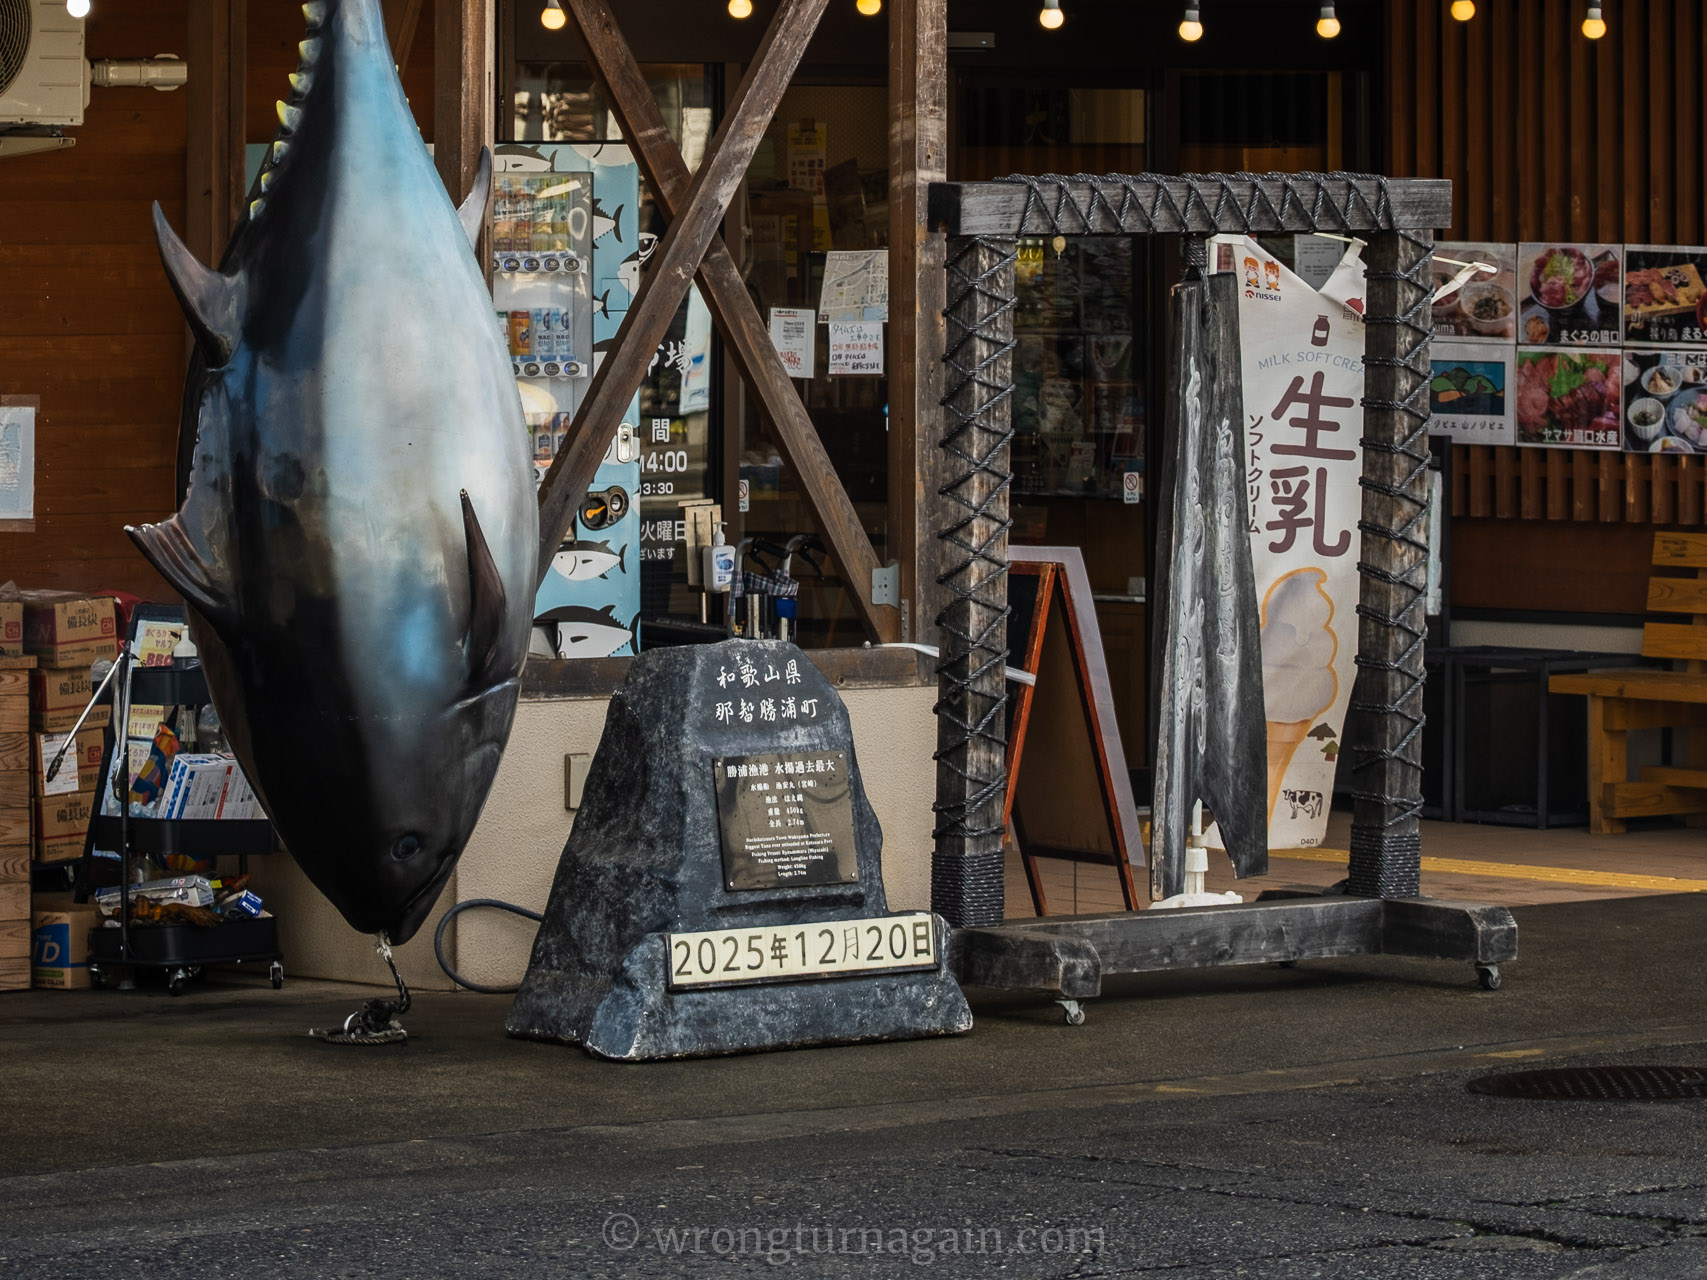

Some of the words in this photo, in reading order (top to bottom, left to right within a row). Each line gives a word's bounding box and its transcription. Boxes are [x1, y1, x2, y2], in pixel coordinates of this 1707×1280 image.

[1256, 293, 1281, 301] NISSEI
[1258, 352, 1290, 370] MILK
[652, 419, 670, 443] 間
[1248, 415, 1263, 534] ソフトクリーム
[1265, 371, 1356, 557] 生乳
[641, 521, 686, 541] 火曜日
[717, 659, 801, 689] 和歌山県
[715, 697, 818, 725] 那智勝浦町
[727, 763, 769, 778] 勝浦漁港
[775, 759, 835, 775] 水揚過去最大
[674, 921, 931, 977] 2025年12月20日
